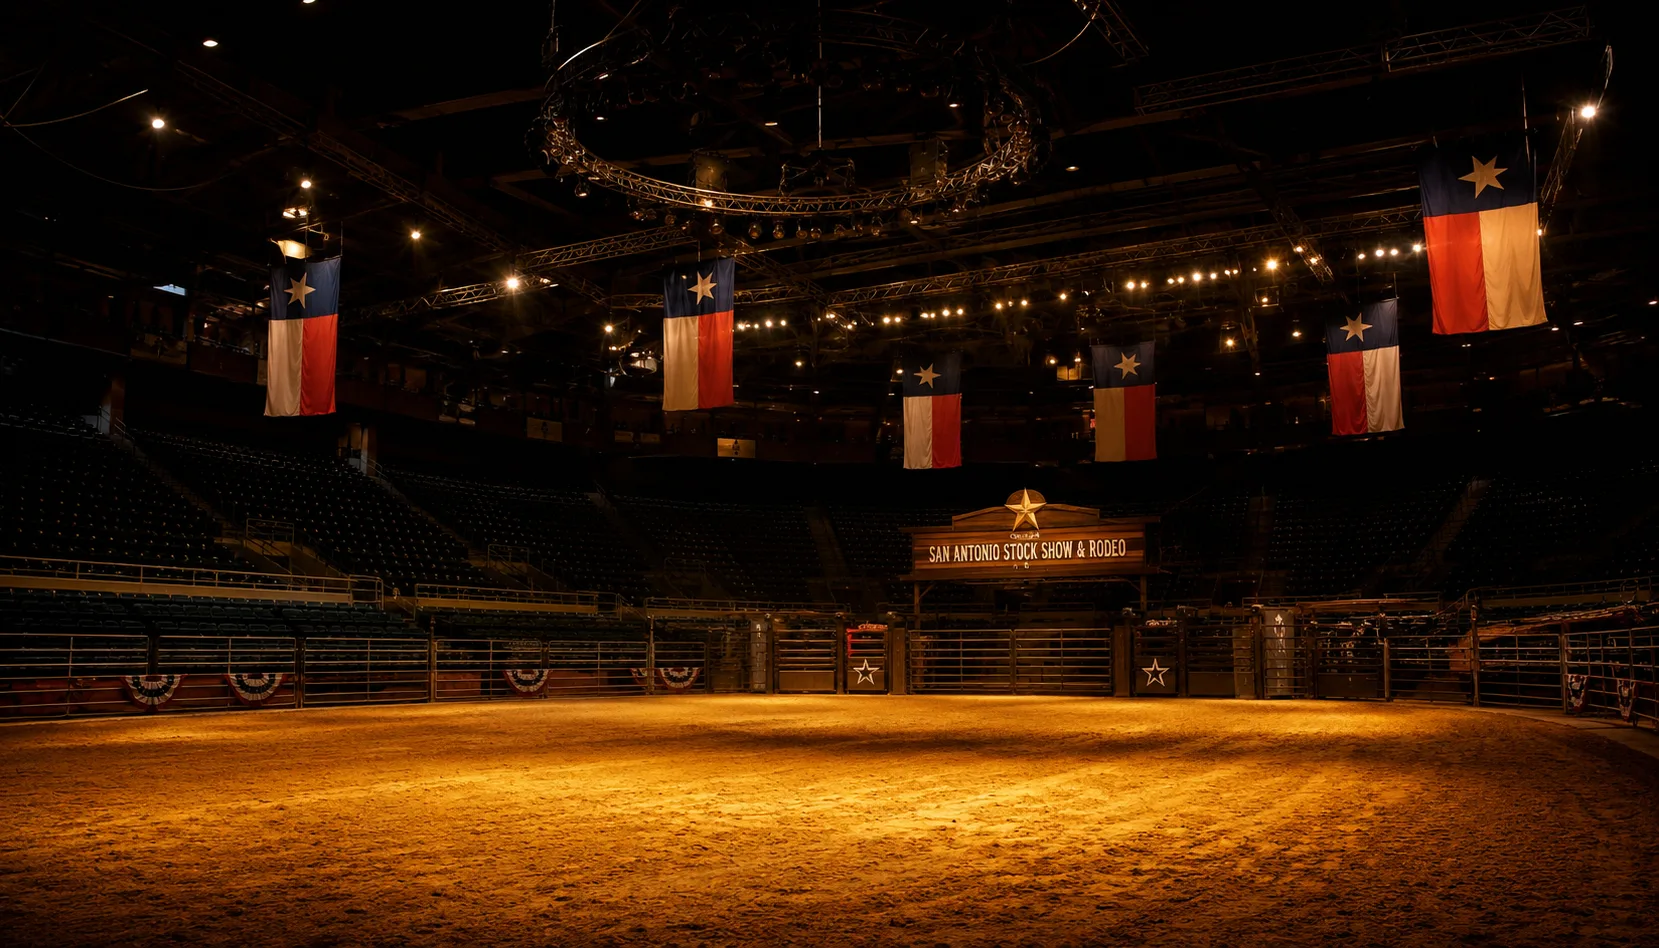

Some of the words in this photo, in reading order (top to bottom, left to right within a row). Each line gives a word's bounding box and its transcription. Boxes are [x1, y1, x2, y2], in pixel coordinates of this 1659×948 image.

[929, 545, 950, 562] SAN
[953, 543, 1000, 561] ANTONIO
[1003, 542, 1038, 560] STOCK
[1041, 540, 1073, 558] SHOW
[1077, 541, 1086, 557] &
[1089, 539, 1126, 557] RODEO
